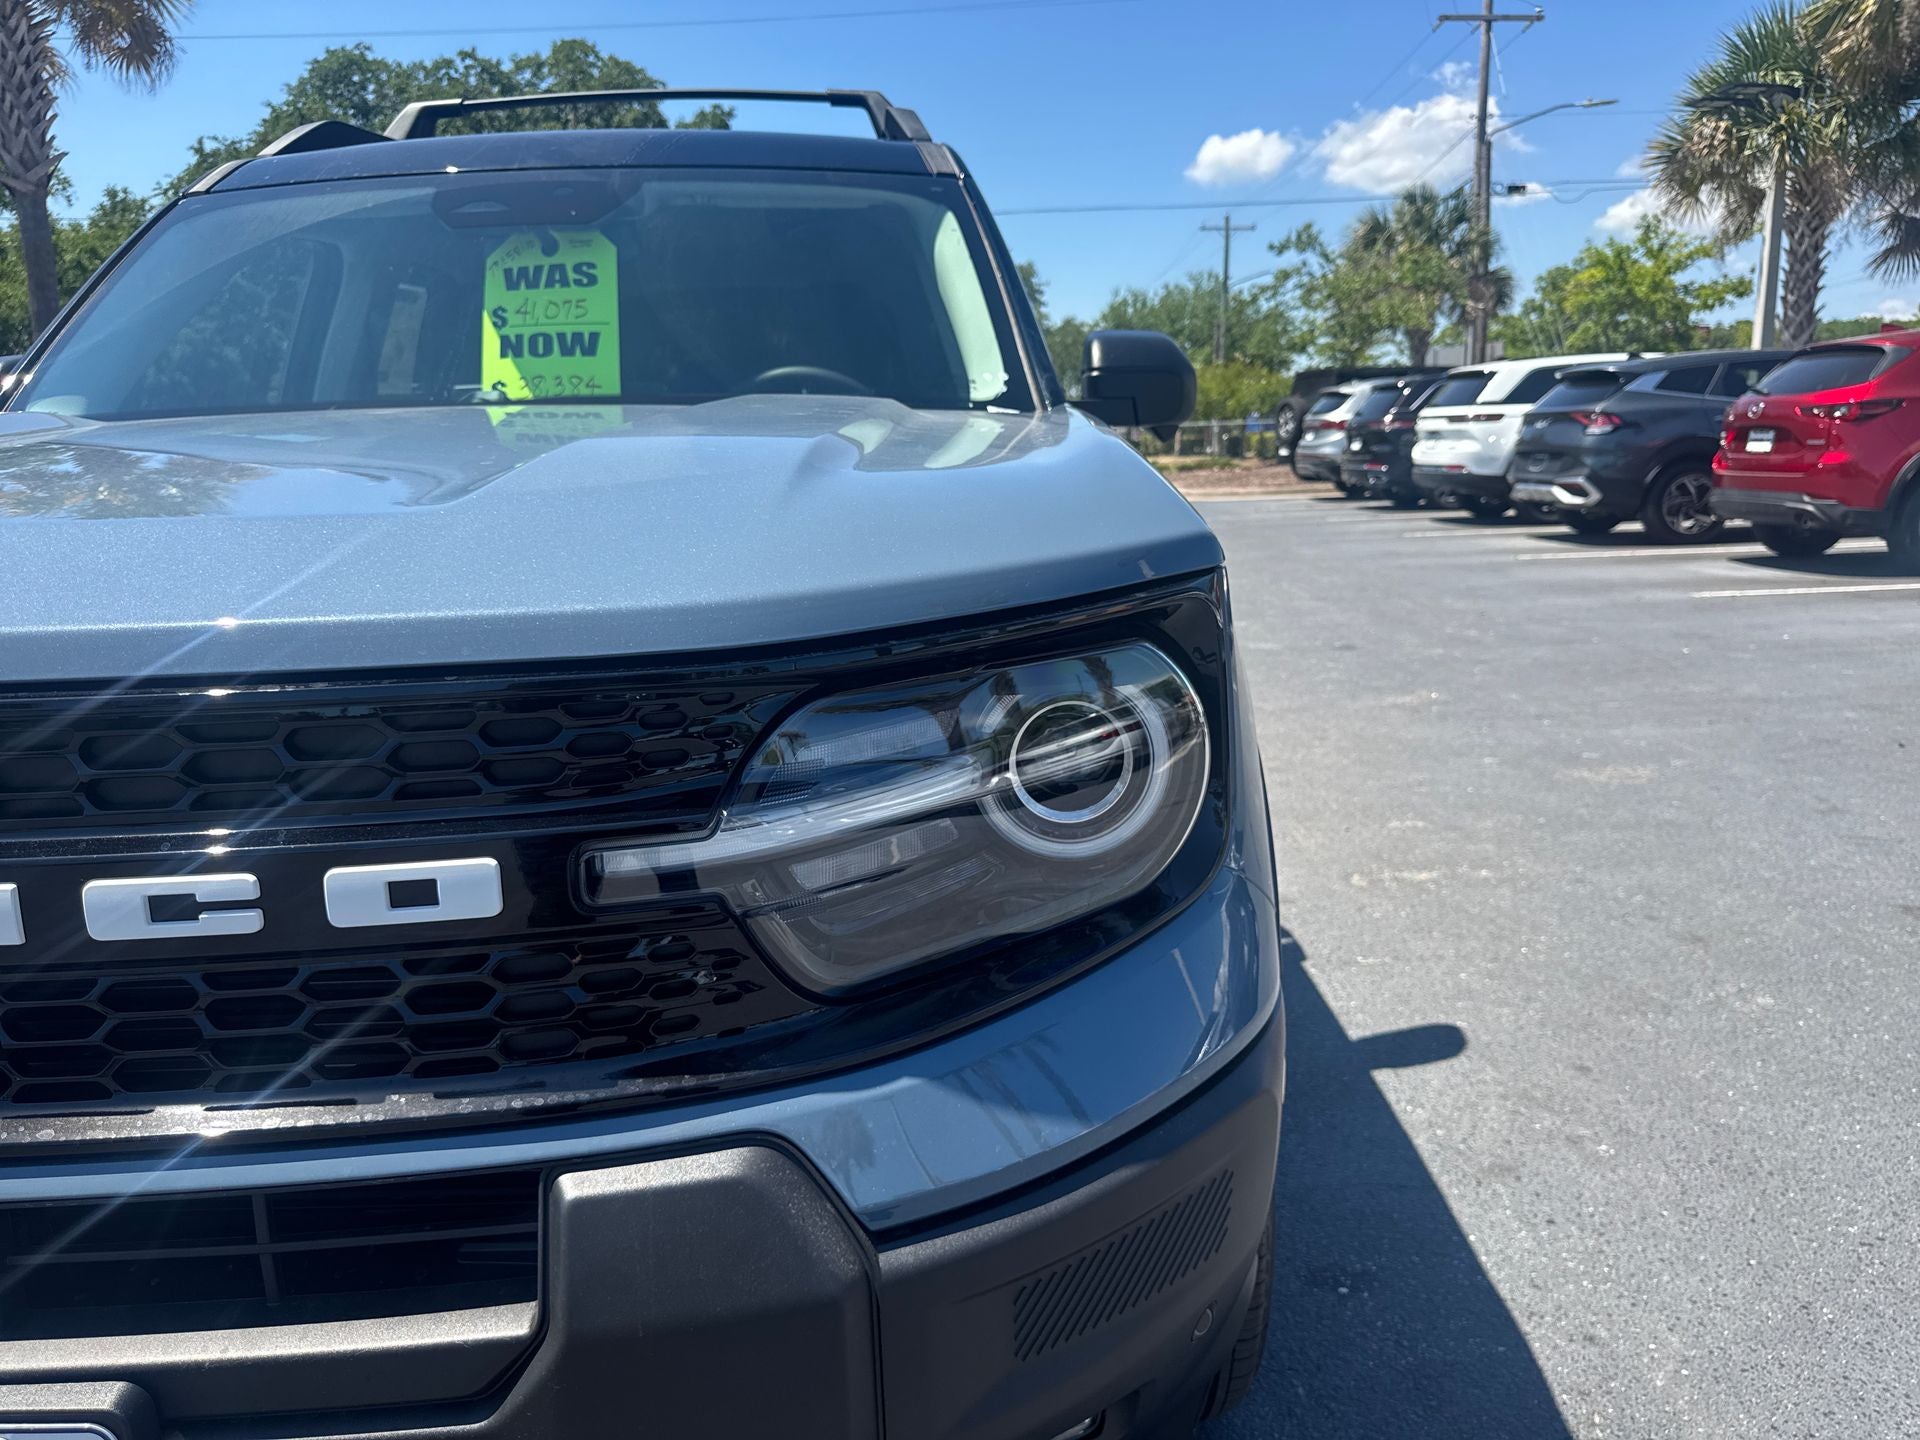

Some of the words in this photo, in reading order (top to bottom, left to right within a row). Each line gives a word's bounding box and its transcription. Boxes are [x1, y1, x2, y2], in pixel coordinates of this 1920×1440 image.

[503, 262, 598, 291] WAS
[491, 305, 508, 329] $
[514, 297, 589, 326] 41,075
[500, 331, 601, 360] NOW
[0, 857, 504, 946] CO
